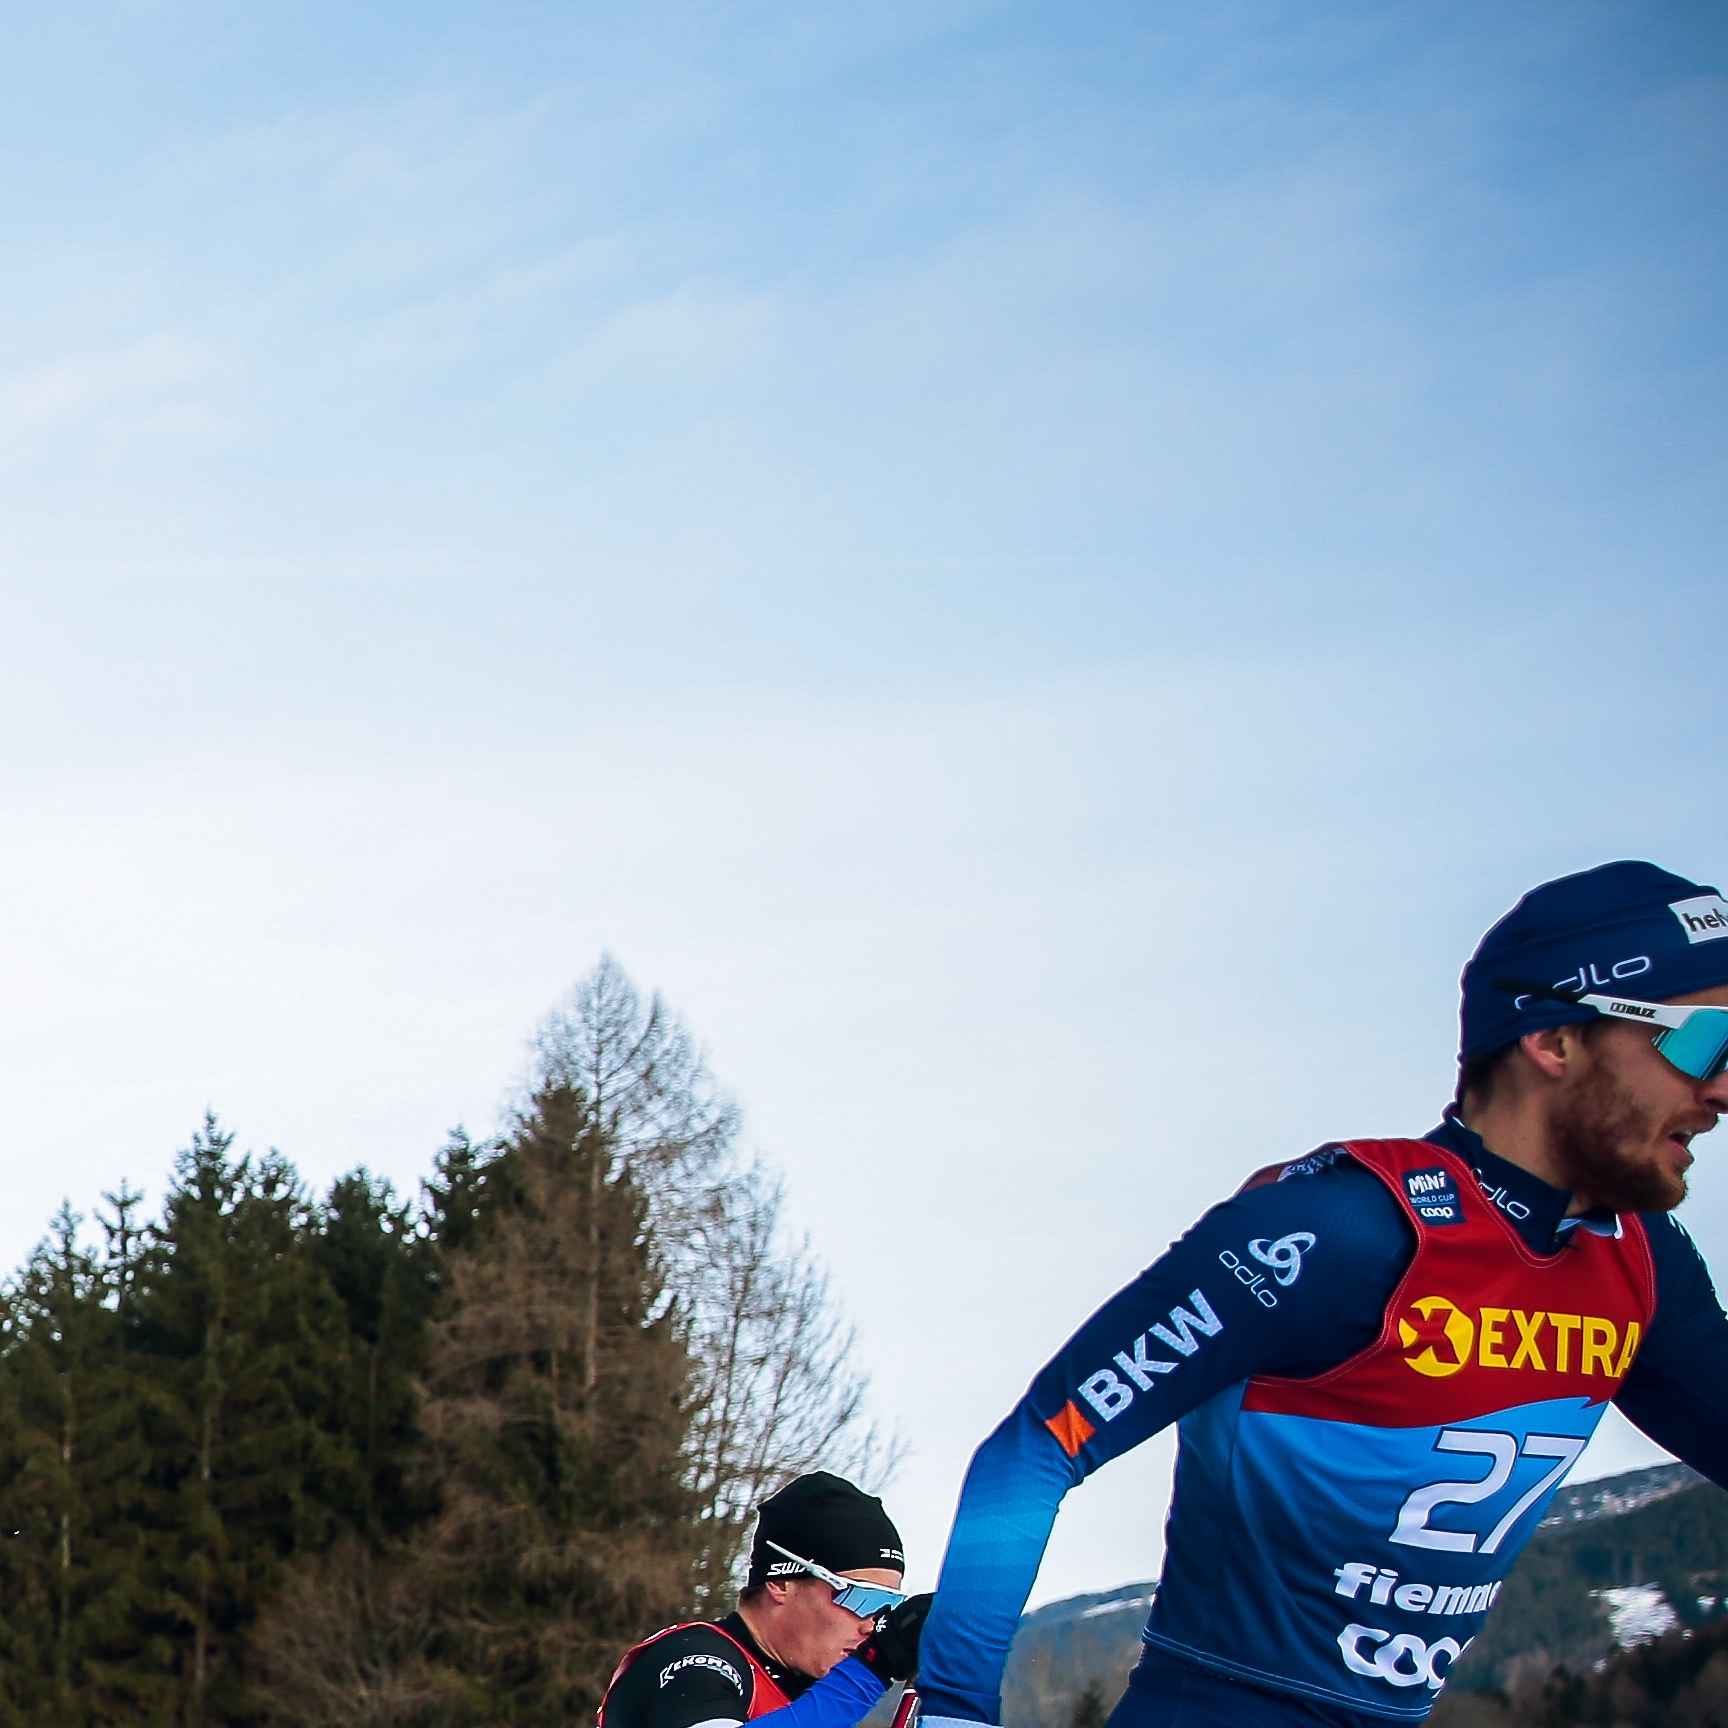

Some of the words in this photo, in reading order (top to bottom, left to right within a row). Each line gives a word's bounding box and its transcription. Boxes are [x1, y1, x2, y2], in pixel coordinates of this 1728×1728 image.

[1218, 1250, 1278, 1308] odlo
[1076, 1288, 1225, 1424] BKW
[1478, 1306, 1640, 1378] EXTRA
[1389, 1429, 1587, 1554] 27
[1336, 1623, 1476, 1700] coo
